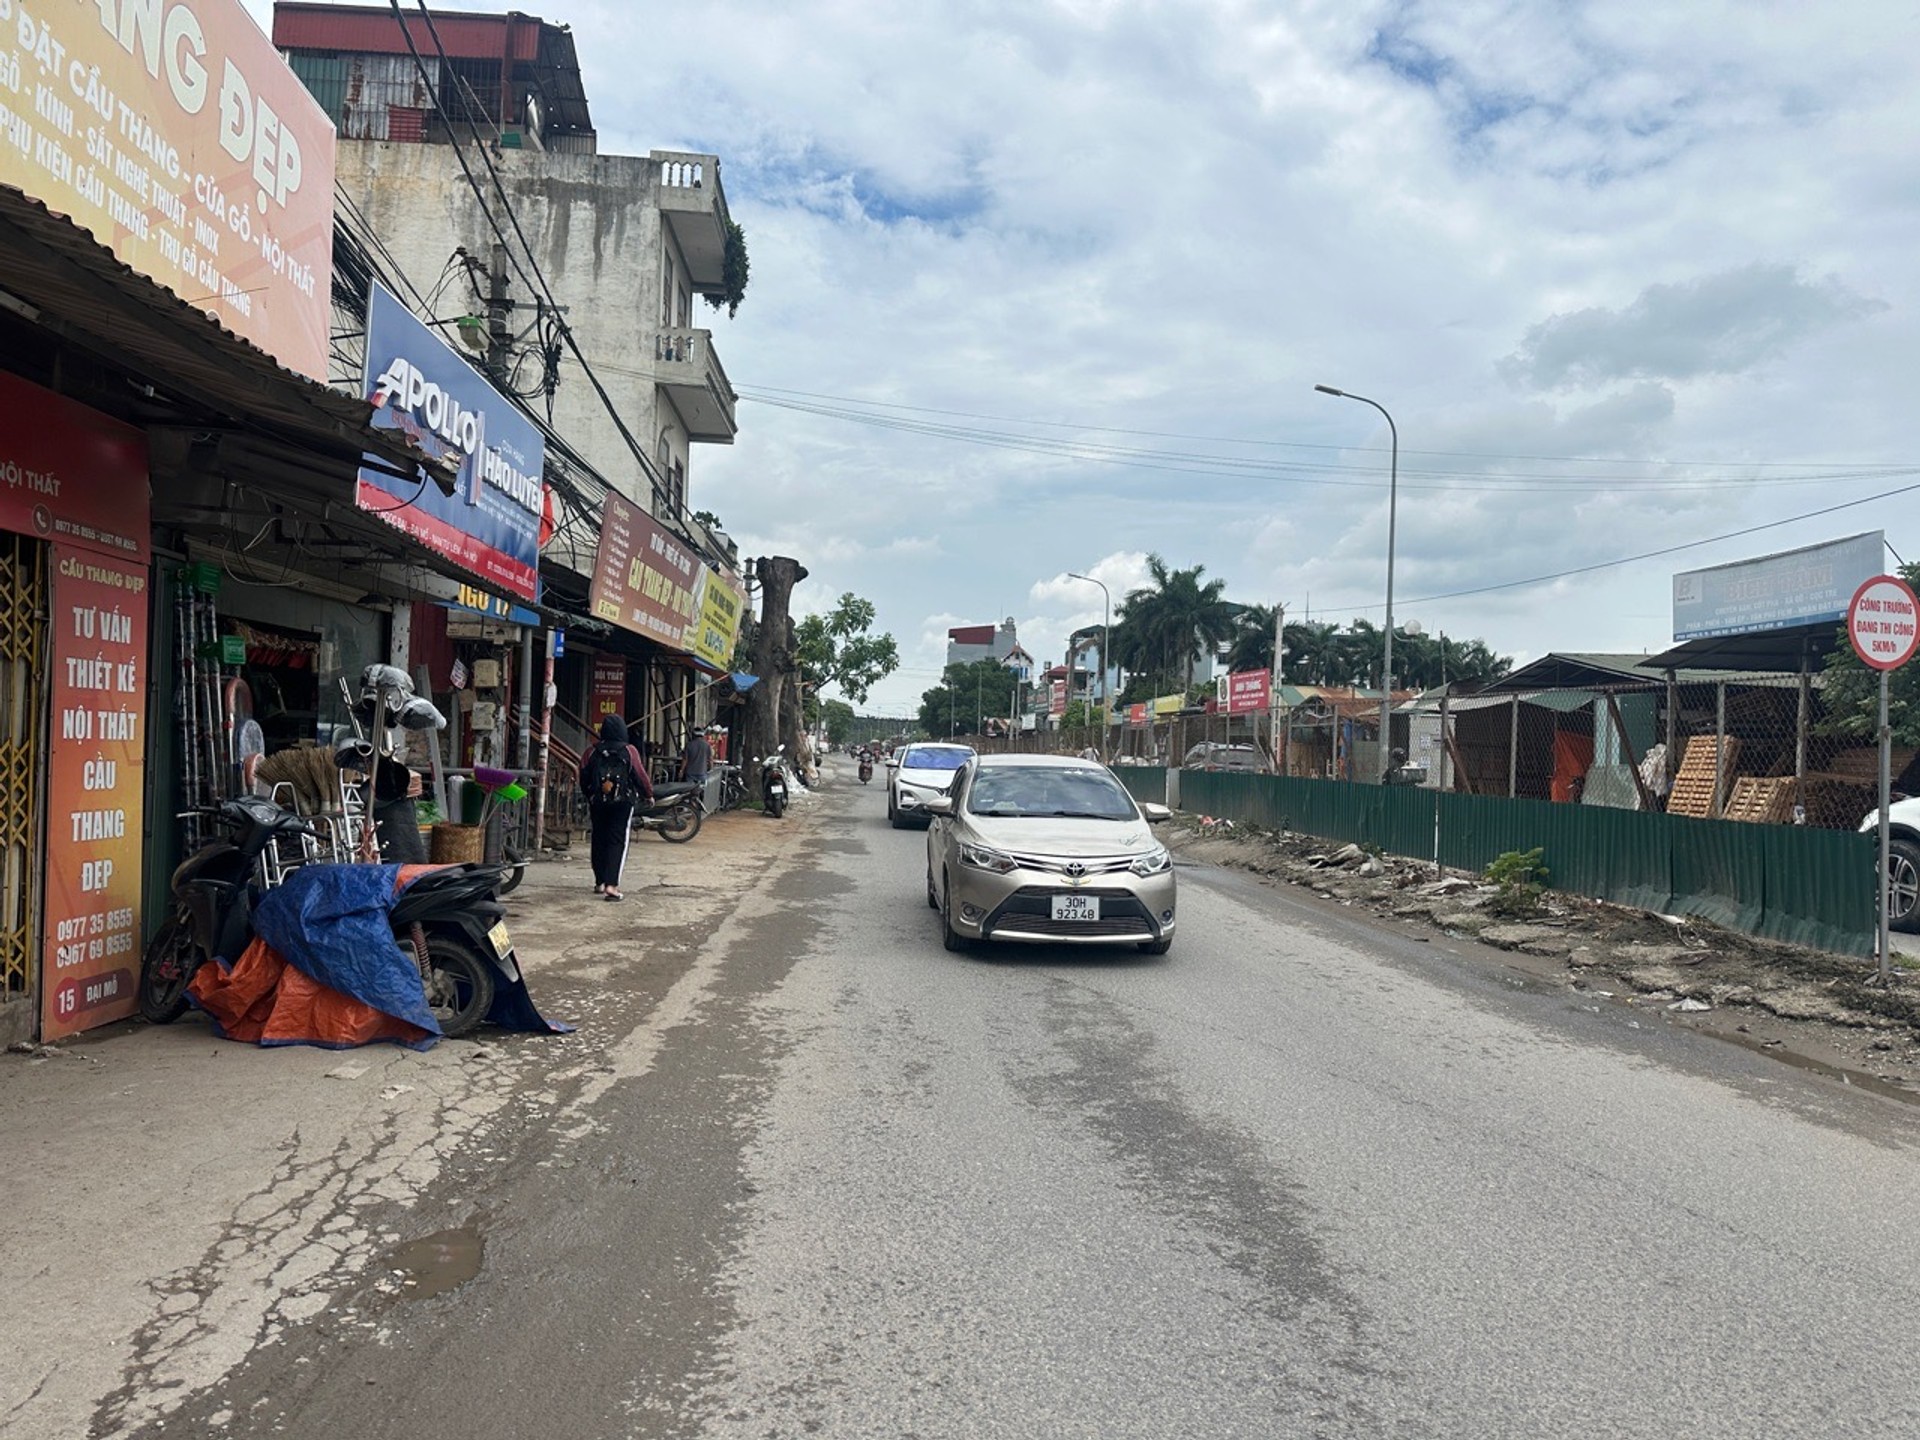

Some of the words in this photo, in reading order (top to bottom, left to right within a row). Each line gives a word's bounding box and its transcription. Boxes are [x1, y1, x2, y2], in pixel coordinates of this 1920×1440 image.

[219, 56, 302, 214] ĐẸP
[17, 8, 66, 78] ĐẶT
[118, 100, 180, 179] THANG
[194, 173, 226, 222] CỬA
[229, 203, 251, 242] GỖ
[262, 241, 286, 278] NỘI
[288, 262, 316, 299] THẤT
[36, 82, 74, 138] KÍNH
[87, 126, 114, 169] SẮT
[115, 150, 150, 205] NGHỆ
[152, 180, 188, 229] THUẬT
[195, 216, 220, 257] INOX
[36, 132, 73, 186] KIỆN
[76, 163, 105, 211] CẦU
[108, 187, 149, 242] THANG
[159, 228, 180, 270] TRỤ
[182, 244, 197, 278] GỖ
[222, 275, 251, 318] THANG
[372, 358, 476, 455] APOLLO
[26, 471, 61, 498] THẤT
[86, 565, 123, 587] THANG
[125, 575, 145, 594] ĐẸP
[1860, 597, 1881, 612] CÔNG
[1883, 599, 1912, 615] TRƯỜNG
[72, 606, 97, 639] TƯ
[100, 605, 131, 644] VẤN
[1857, 620, 1878, 634] ĐANG
[1880, 622, 1892, 634] THI
[1894, 621, 1914, 637] CÔNG
[66, 652, 112, 690] THIẾT
[117, 656, 136, 692] KẾ
[62, 705, 92, 745] NỘI
[98, 703, 137, 740] THẤT
[83, 751, 117, 790] CẦU
[71, 809, 125, 842] THANG
[82, 859, 113, 895] ĐẸP
[1056, 908, 1095, 920] 923.48
[1065, 897, 1086, 908] 30H
[57, 917, 87, 942] 0977
[90, 913, 104, 935] 35
[107, 908, 133, 931] 8555
[57, 942, 86, 969] 0967
[89, 938, 104, 960] 69
[106, 932, 133, 956] 8555
[58, 988, 75, 1014] 15
[86, 983, 102, 1004] ĐẠI
